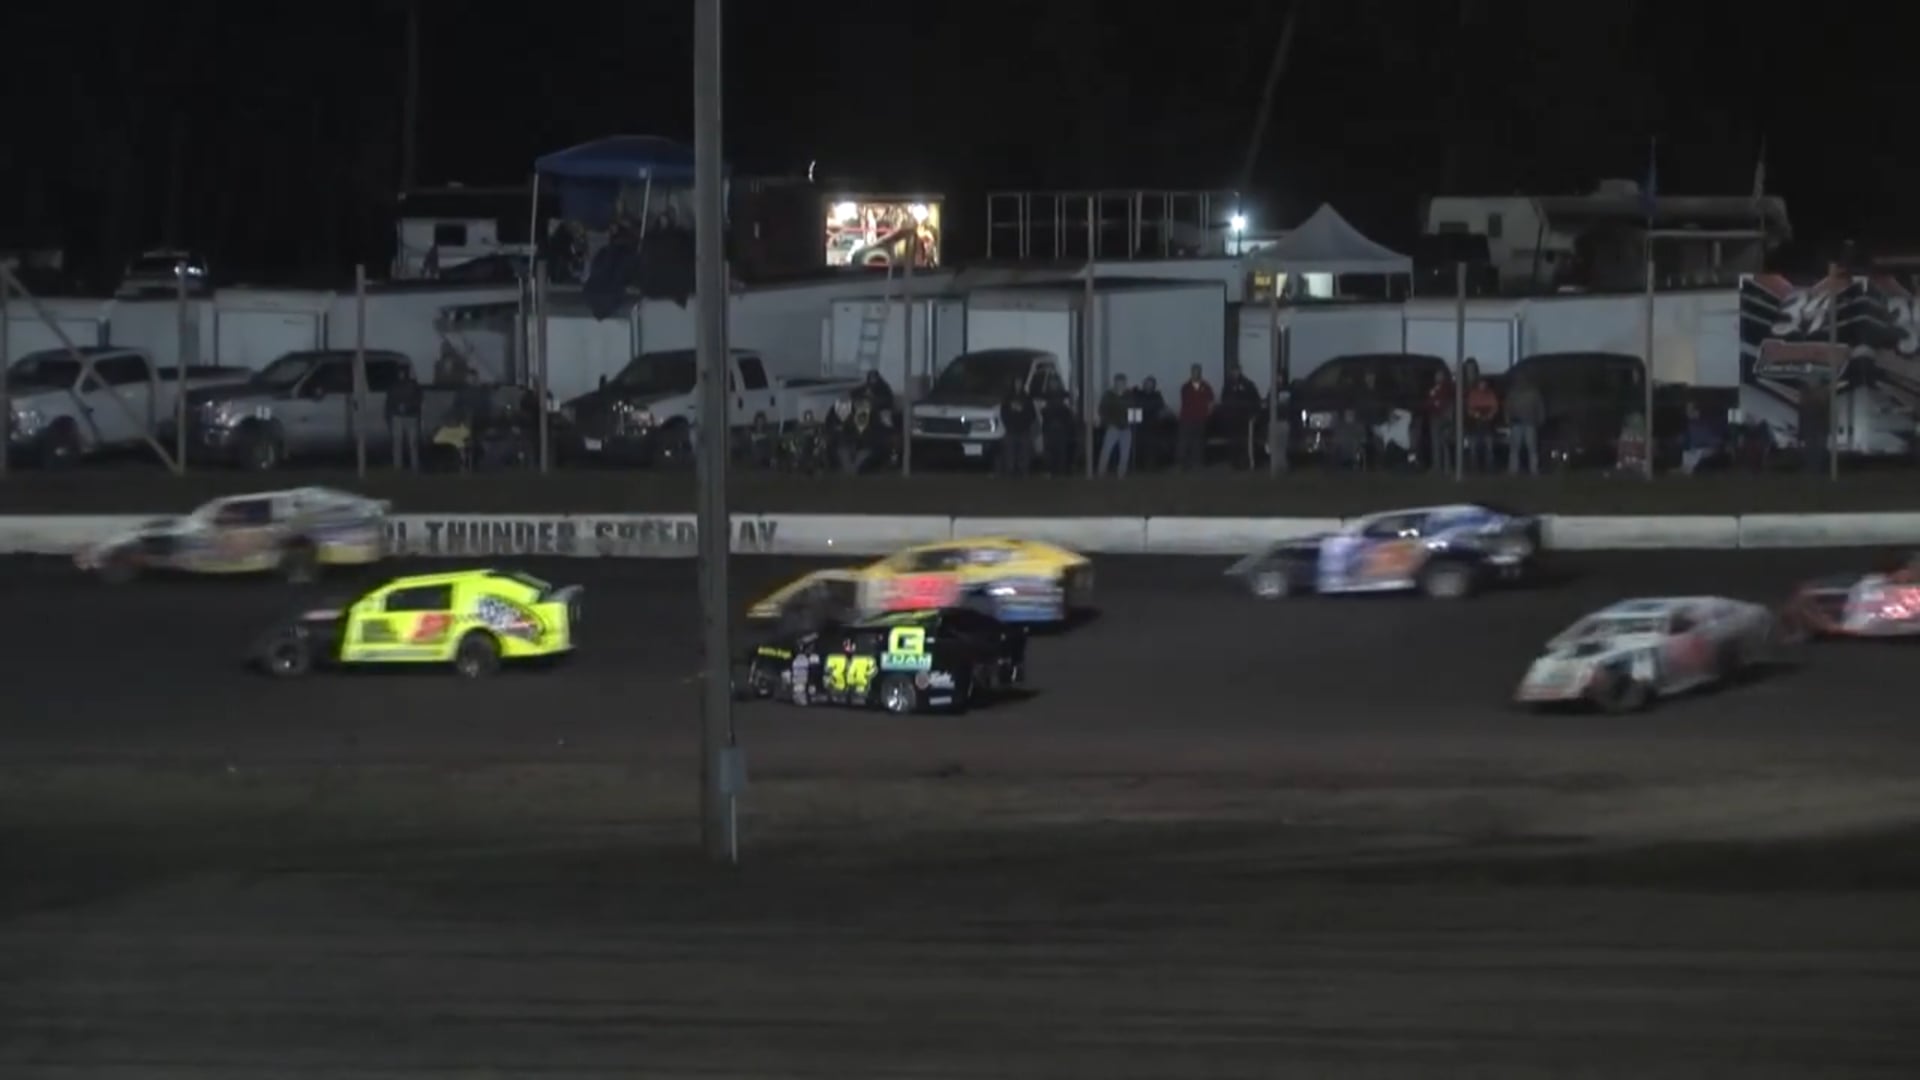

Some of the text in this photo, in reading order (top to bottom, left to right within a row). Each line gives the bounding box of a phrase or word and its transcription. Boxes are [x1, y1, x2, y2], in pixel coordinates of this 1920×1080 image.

[425, 521, 577, 552] THUNDER
[595, 520, 778, 552] SPEEDAY
[826, 654, 877, 692] 34
